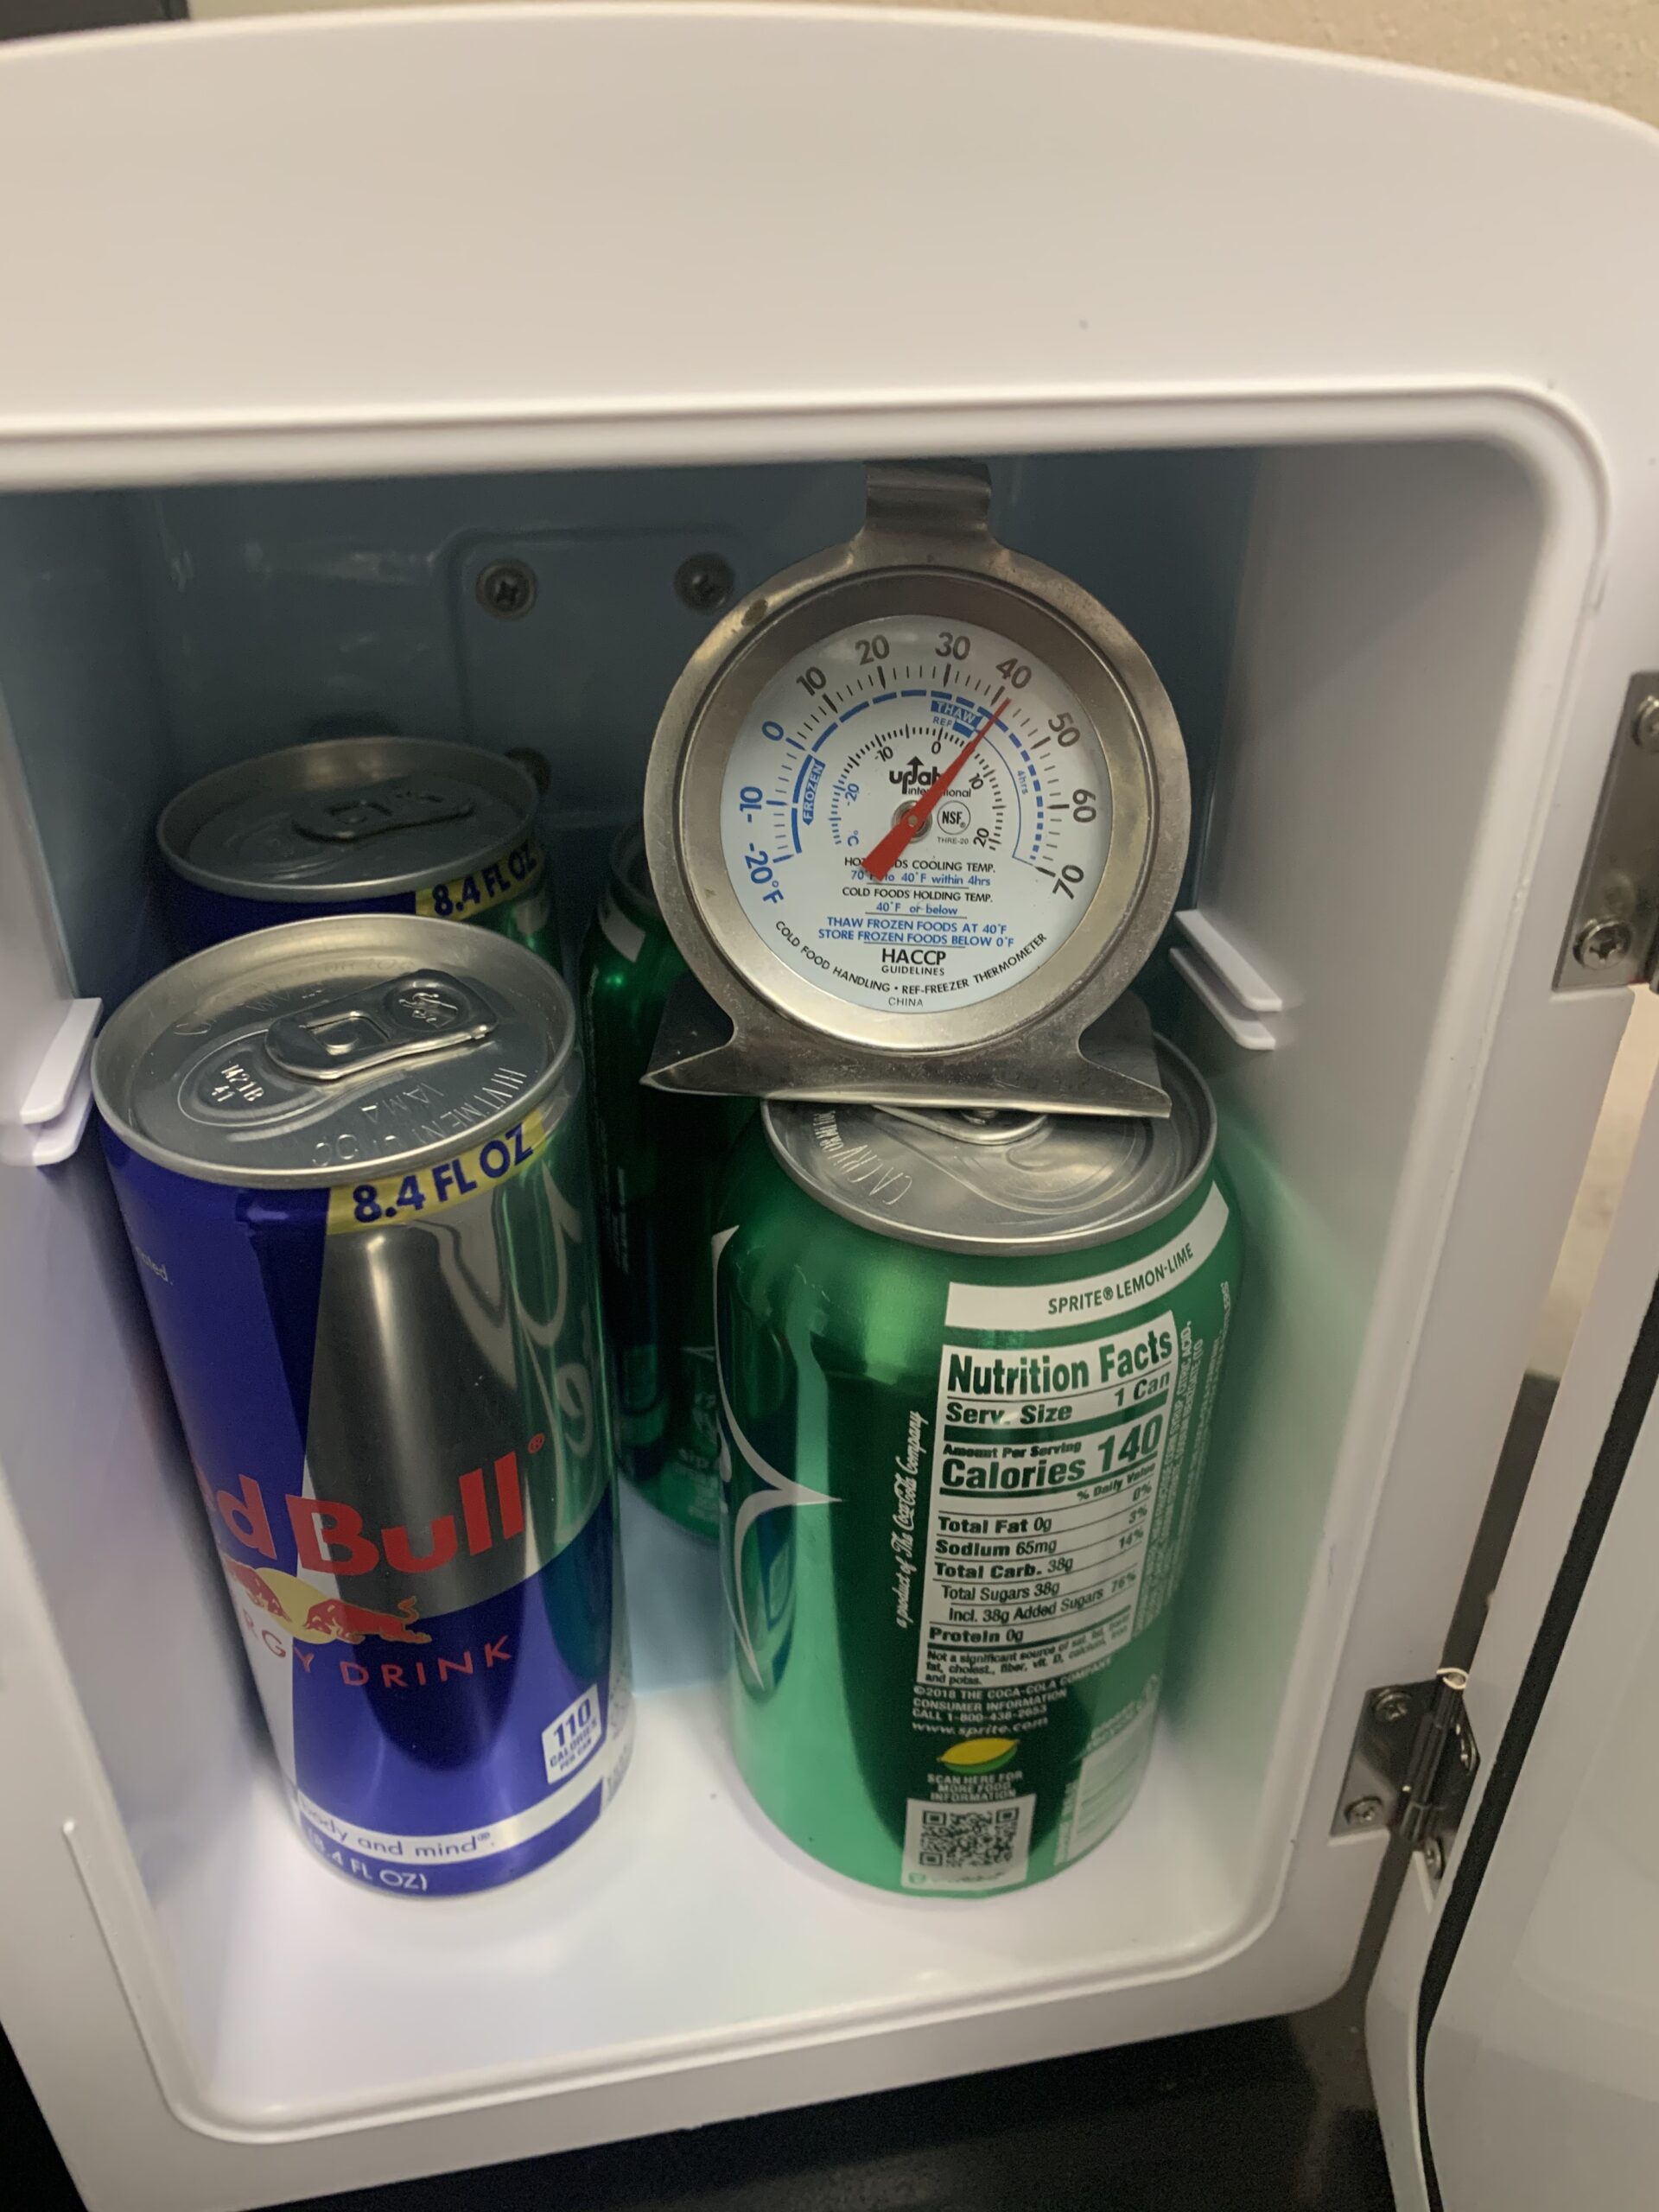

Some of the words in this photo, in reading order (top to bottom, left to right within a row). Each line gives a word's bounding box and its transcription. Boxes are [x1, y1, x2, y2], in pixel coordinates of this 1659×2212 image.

[855, 635, 891, 665] 20
[934, 632, 970, 661] 30
[796, 665, 828, 696] 10
[995, 658, 1032, 689] 40
[936, 701, 977, 726] THAW
[761, 720, 785, 741] 0
[1048, 712, 1080, 747] 50
[874, 746, 894, 762] -10
[931, 741, 941, 754] 0
[803, 763, 825, 823] FROZEN
[969, 773, 983, 790] 10
[739, 786, 764, 823] -10
[845, 783, 860, 806] -20
[1072, 788, 1097, 823] 60
[937, 836, 969, 845] THRE-20
[974, 828, 989, 848] 20
[912, 860, 963, 872] COOLING
[967, 862, 996, 874] TEMP.
[432, 874, 481, 916] 8.4
[480, 861, 511, 899] FL
[507, 844, 538, 880] OZ
[931, 874, 963, 885] within
[968, 876, 990, 887] 4hrs
[1052, 865, 1084, 900] 70
[842, 887, 870, 897] COLD
[874, 887, 910, 899] FOODS
[913, 890, 961, 901] HOLDING
[965, 893, 994, 903] TEMP.
[925, 905, 958, 915] below
[827, 917, 863, 927] THAW
[867, 918, 913, 930] FROZEN
[917, 921, 957, 932] FOODS
[963, 924, 978, 933] AT
[818, 930, 855, 940] STORE
[857, 931, 904, 943] FROZEN
[907, 933, 948, 944] FOODS
[951, 936, 992, 946] BELOW
[774, 919, 802, 948] COLD
[800, 944, 830, 973] FOOD
[832, 966, 891, 993] HANDLING
[901, 978, 970, 995] REF-FREEZER
[974, 931, 1048, 984] THERMOMETER
[881, 949, 946, 965] HACCP
[881, 965, 945, 976] GUIDELINES
[888, 996, 924, 1007] CHINA
[353, 1176, 426, 1224] 8.4
[432, 1164, 477, 1203] FL
[480, 1123, 535, 1179] OZ
[1116, 1243, 1194, 1300] LEMON-LIME
[948, 1353, 1090, 1396] Nutrition
[1099, 1328, 1173, 1383] Facts
[945, 1402, 1012, 1425] Serv.
[1020, 1403, 1072, 1425] Size
[1114, 1387, 1124, 1407] 1
[1133, 1370, 1170, 1402] Can
[895, 1410, 929, 1476] Company
[941, 1457, 1086, 1491] Calories
[1097, 1413, 1163, 1473] 140
[943, 1443, 997, 1459] Amount
[1002, 1445, 1027, 1459] Per
[1029, 1440, 1082, 1459] Serving
[1077, 1491, 1090, 1502] %
[1093, 1478, 1123, 1497] Daily
[938, 1516, 988, 1535] Total
[995, 1514, 1029, 1534] Fat
[1033, 1516, 1052, 1534] 0g
[1132, 1481, 1152, 1502] 0%
[935, 1539, 1011, 1557] Sodium
[1015, 1538, 1057, 1557] 65mg
[1128, 1504, 1147, 1524] 3%
[890, 1530, 913, 1558] The
[934, 1561, 984, 1579] Total
[990, 1558, 1042, 1579] Carb.
[1046, 1555, 1074, 1575] 38g
[1119, 1528, 1144, 1549] 14%
[895, 1555, 917, 1574] of
[892, 1575, 913, 1624] product
[940, 1583, 976, 1601] Total
[980, 1584, 1030, 1604] Sugars
[1033, 1580, 1060, 1599] 38g
[949, 1606, 978, 1622] Incl.
[982, 1606, 1010, 1624] 38g
[1013, 1601, 1057, 1621] Added
[1060, 1585, 1104, 1612] Sugars
[929, 1625, 1001, 1643] Protein
[1005, 1628, 1024, 1643] 0g
[340, 1635, 512, 1688] DRINK
[927, 1650, 948, 1662] Not
[950, 1654, 957, 1662] a
[960, 1651, 1018, 1665] significant
[1020, 1645, 1056, 1661] source
[925, 1674, 945, 1684] and
[960, 1689, 982, 1700] THE
[987, 1681, 1057, 1699] COCA-COLA
[912, 1698, 982, 1712] CONSUMER
[986, 1688, 1067, 1710] INFORMATION
[554, 1698, 591, 1746] 110
[912, 1708, 943, 1720] CALL
[550, 1717, 597, 1768] CALORIES
[927, 1773, 962, 1784] SCAN
[963, 1774, 995, 1784] HERE
[998, 1770, 1023, 1782] FOR
[938, 1784, 973, 1794] MORE
[930, 1789, 1016, 1802] INFORMATION
[358, 1837, 403, 1856] and
[350, 1859, 372, 1880] FL
[380, 1869, 428, 1891] OZ)
